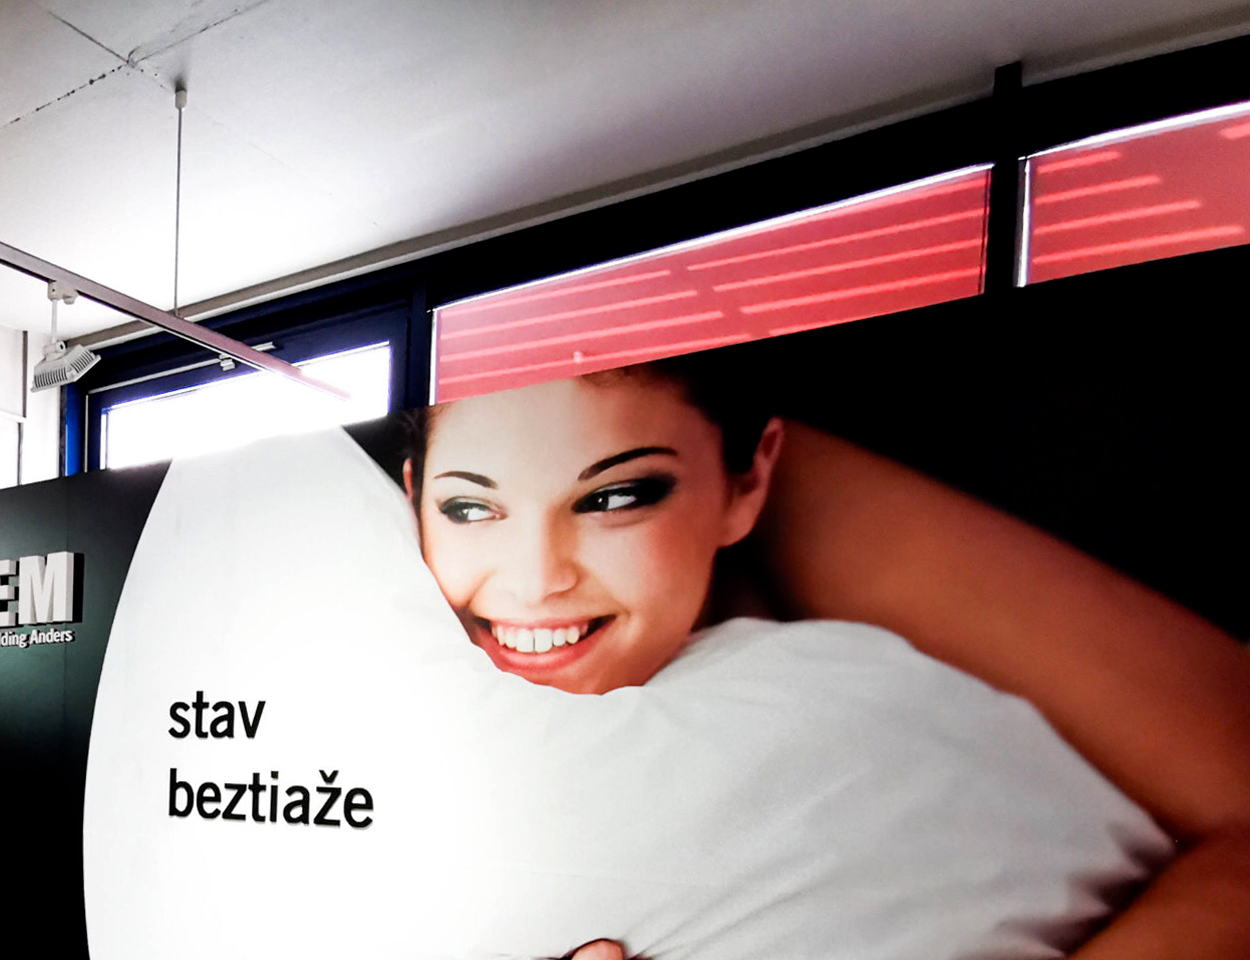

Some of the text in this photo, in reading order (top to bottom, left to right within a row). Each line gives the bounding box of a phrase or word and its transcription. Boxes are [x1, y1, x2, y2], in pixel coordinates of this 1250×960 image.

[29, 628, 73, 644] Anders
[168, 690, 266, 739] stav
[168, 767, 374, 829] beztiaže
